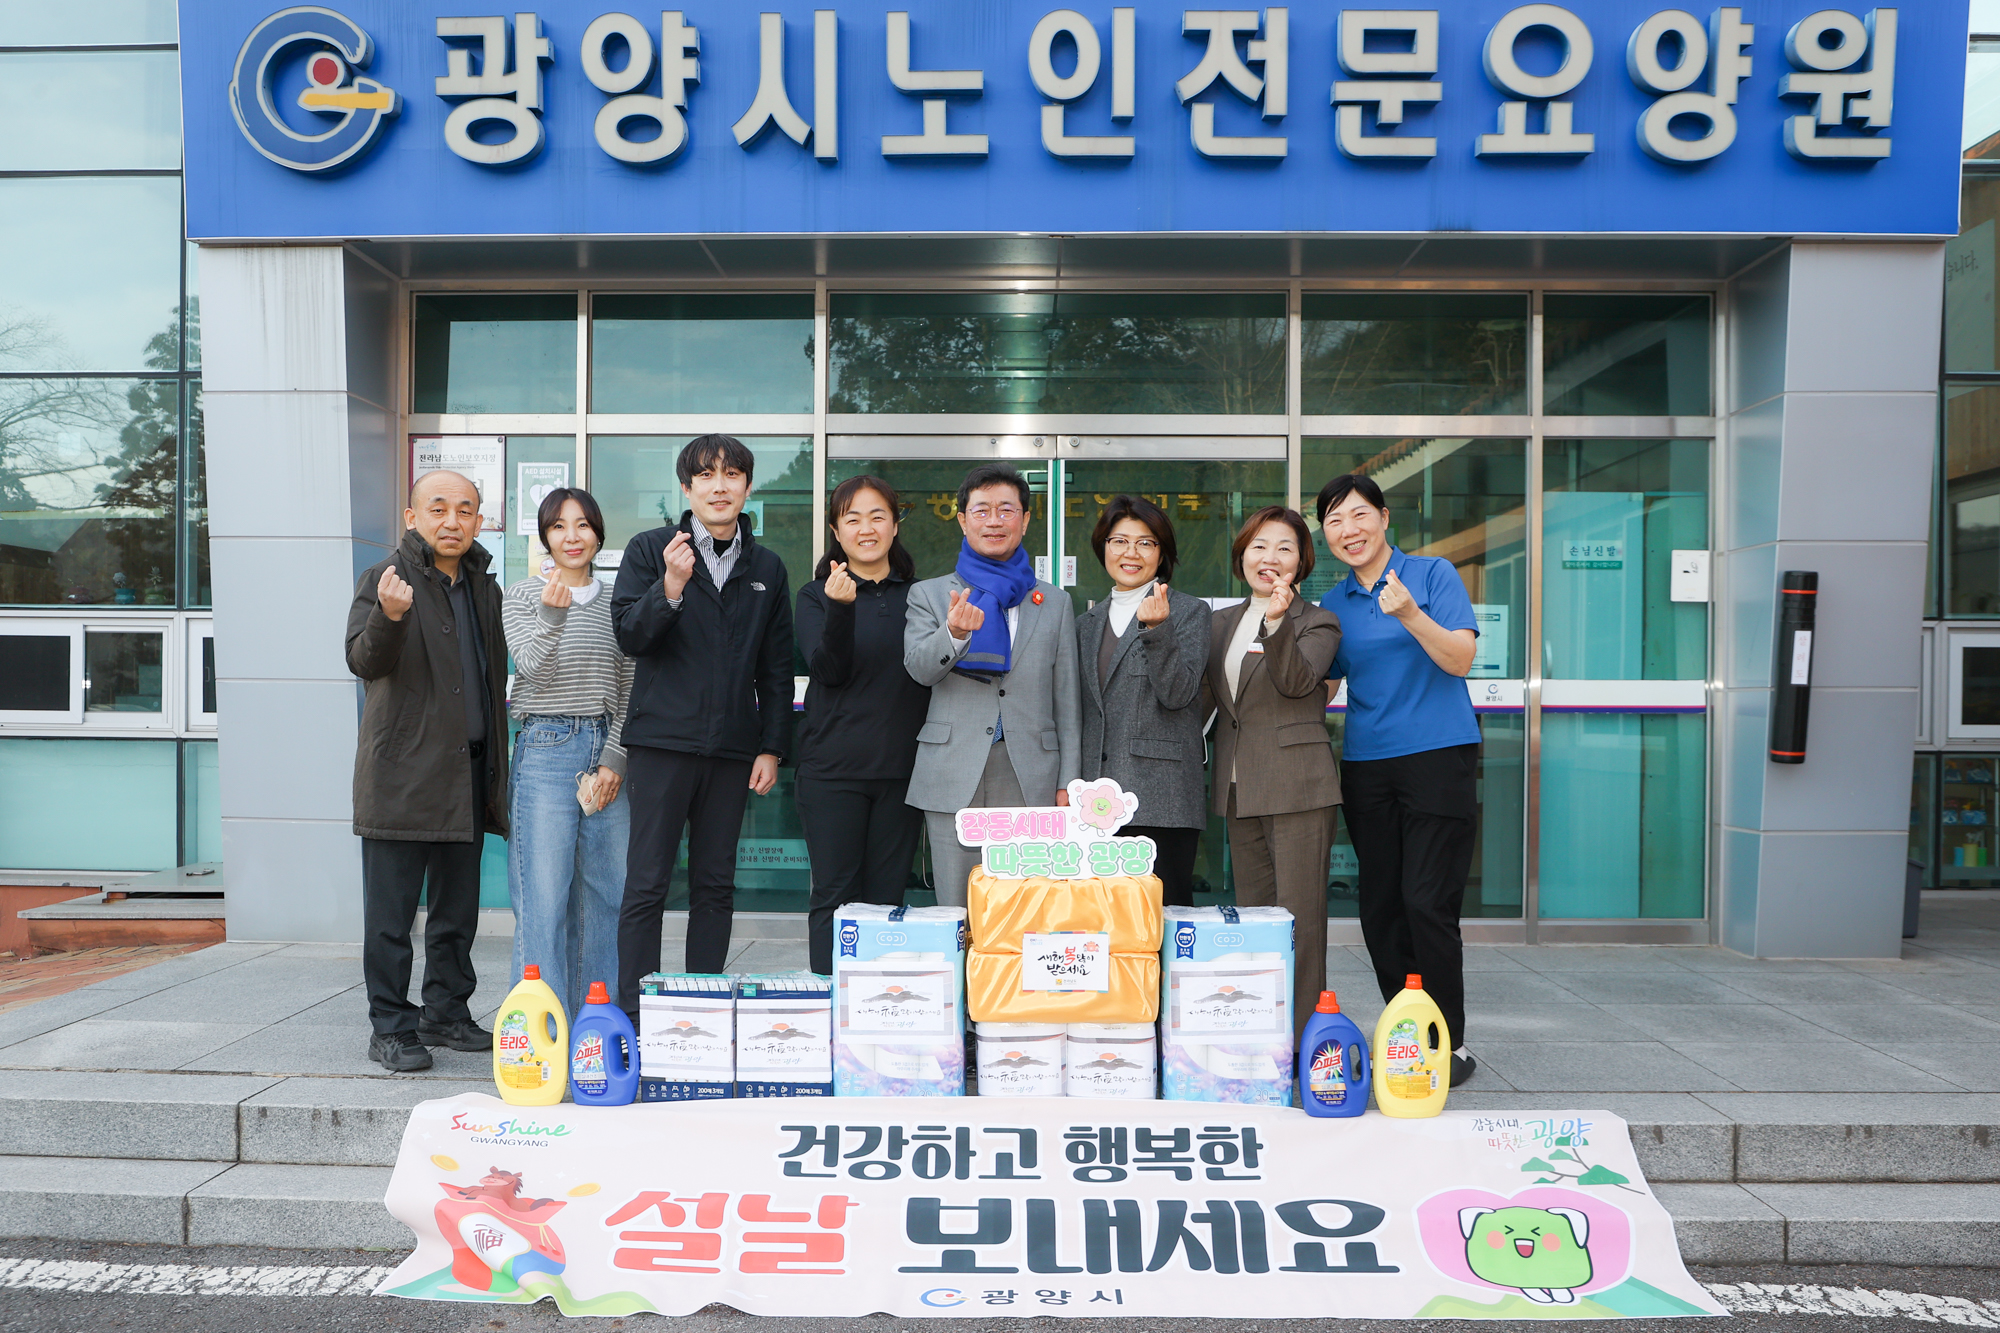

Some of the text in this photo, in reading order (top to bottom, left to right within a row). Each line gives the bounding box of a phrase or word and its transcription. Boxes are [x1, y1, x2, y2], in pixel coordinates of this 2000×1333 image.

[433, 4, 1899, 167] 광양시노인전문요양원
[961, 811, 1067, 842] 감동시대
[986, 841, 1153, 877] 따뜻한 광양
[1037, 946, 1095, 966] 새해 복 많이
[1046, 963, 1091, 976] 받으세요
[500, 1035, 529, 1050] 트리오
[574, 1044, 602, 1061] 스파크
[1386, 1044, 1419, 1060] 트리오
[1311, 1054, 1341, 1072] 스파크
[451, 1112, 577, 1137] Sunshine
[470, 1136, 549, 1148] GWANGYANG
[1487, 1117, 1594, 1153] 따뜻한 광양
[778, 1124, 1264, 1183] 건강하고 행복한
[604, 1190, 1401, 1275] 설날 보내세요
[980, 1288, 1124, 1306] 광양시
